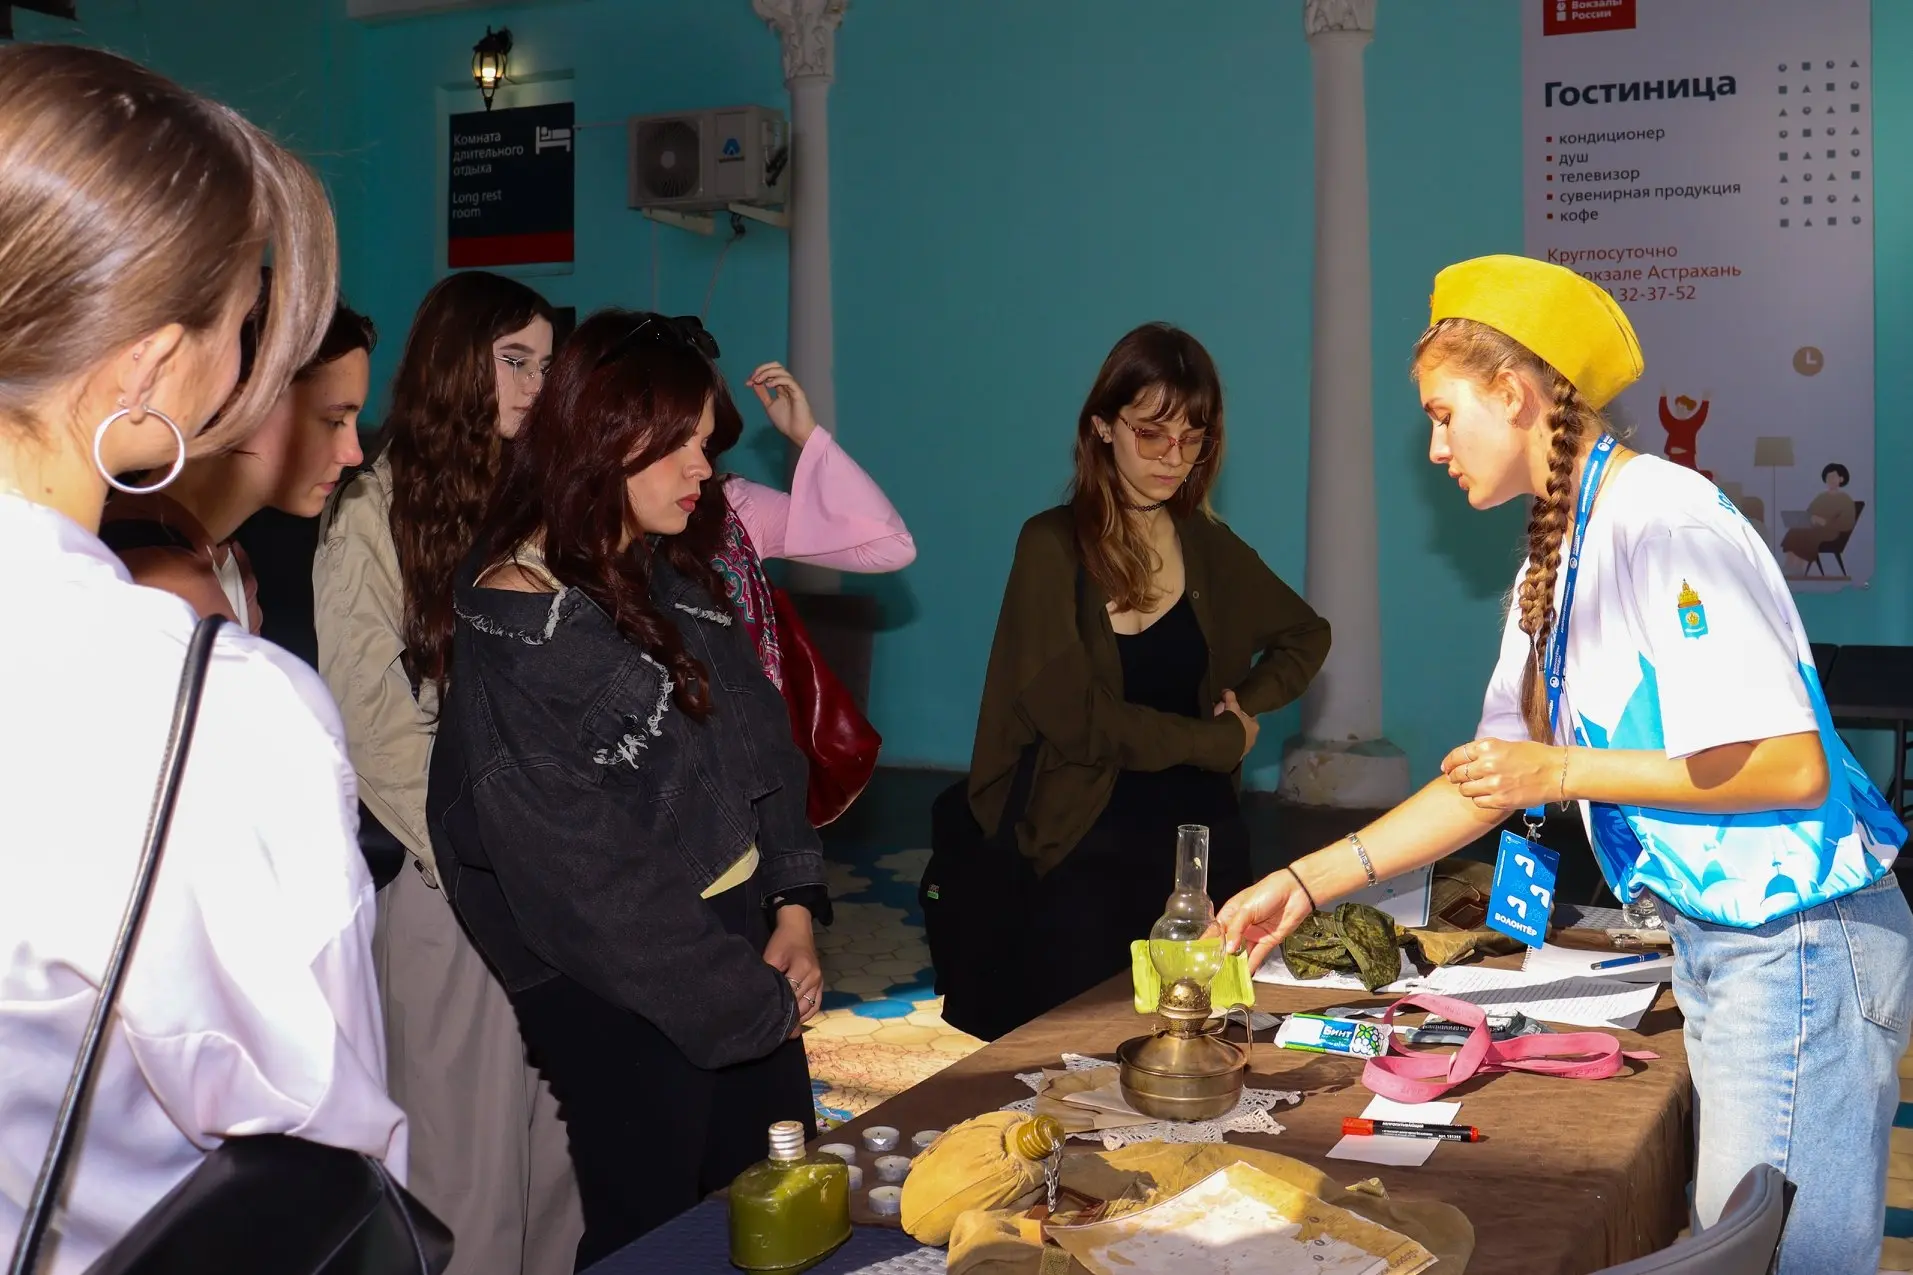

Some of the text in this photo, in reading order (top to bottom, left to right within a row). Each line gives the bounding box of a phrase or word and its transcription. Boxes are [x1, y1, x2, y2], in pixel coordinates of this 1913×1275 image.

[1571, 10, 1612, 20] России
[1544, 75, 1737, 107] Гостиница
[453, 131, 501, 146] Комната
[1559, 127, 1665, 145] кондиционер
[453, 145, 524, 162] длительного
[1559, 151, 1589, 166] душ
[453, 163, 492, 176] отдыха
[1560, 168, 1640, 183] телевизор
[453, 190, 502, 206] Long rest
[1560, 183, 1741, 203] сувенирная продукция
[453, 208, 481, 219] room
[1560, 208, 1599, 223] кофе
[1547, 246, 1678, 263] Круглосуточно
[1647, 264, 1742, 281] Астрахань
[1619, 286, 1696, 302] 32-37-52
[1494, 913, 1538, 937] ВОЛОНТЁР
